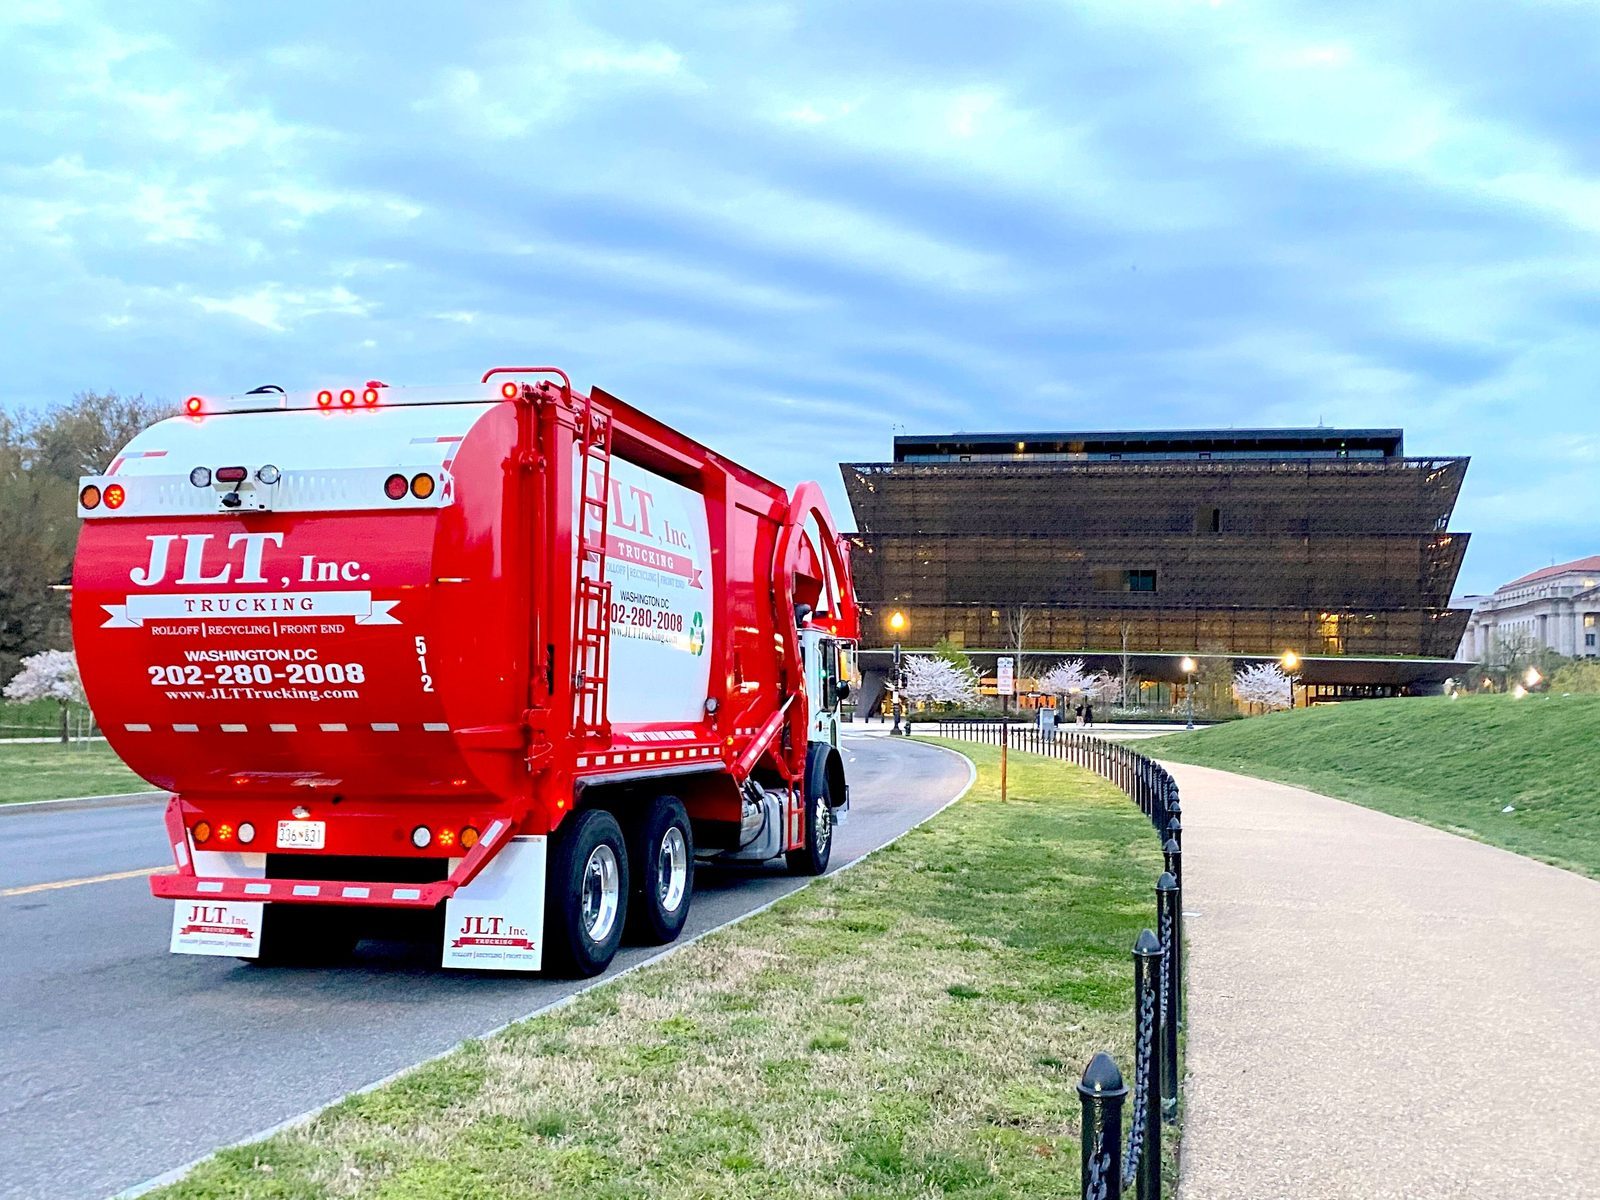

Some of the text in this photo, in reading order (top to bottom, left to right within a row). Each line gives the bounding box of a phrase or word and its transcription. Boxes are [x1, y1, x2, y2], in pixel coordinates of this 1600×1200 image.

[664, 520, 691, 549] Inc.
[618, 542, 674, 569] TRUCKING
[298, 554, 371, 582] Inc.
[185, 597, 315, 612] TRUCKING
[151, 624, 345, 635] ROLLOFF RECYCLING FRONT END
[294, 648, 318, 661] DC
[147, 663, 365, 685] 202-280-2008
[165, 687, 359, 701] www.JLTTrucking.com
[231, 915, 249, 926] Inc.
[508, 926, 528, 936] Inc.
